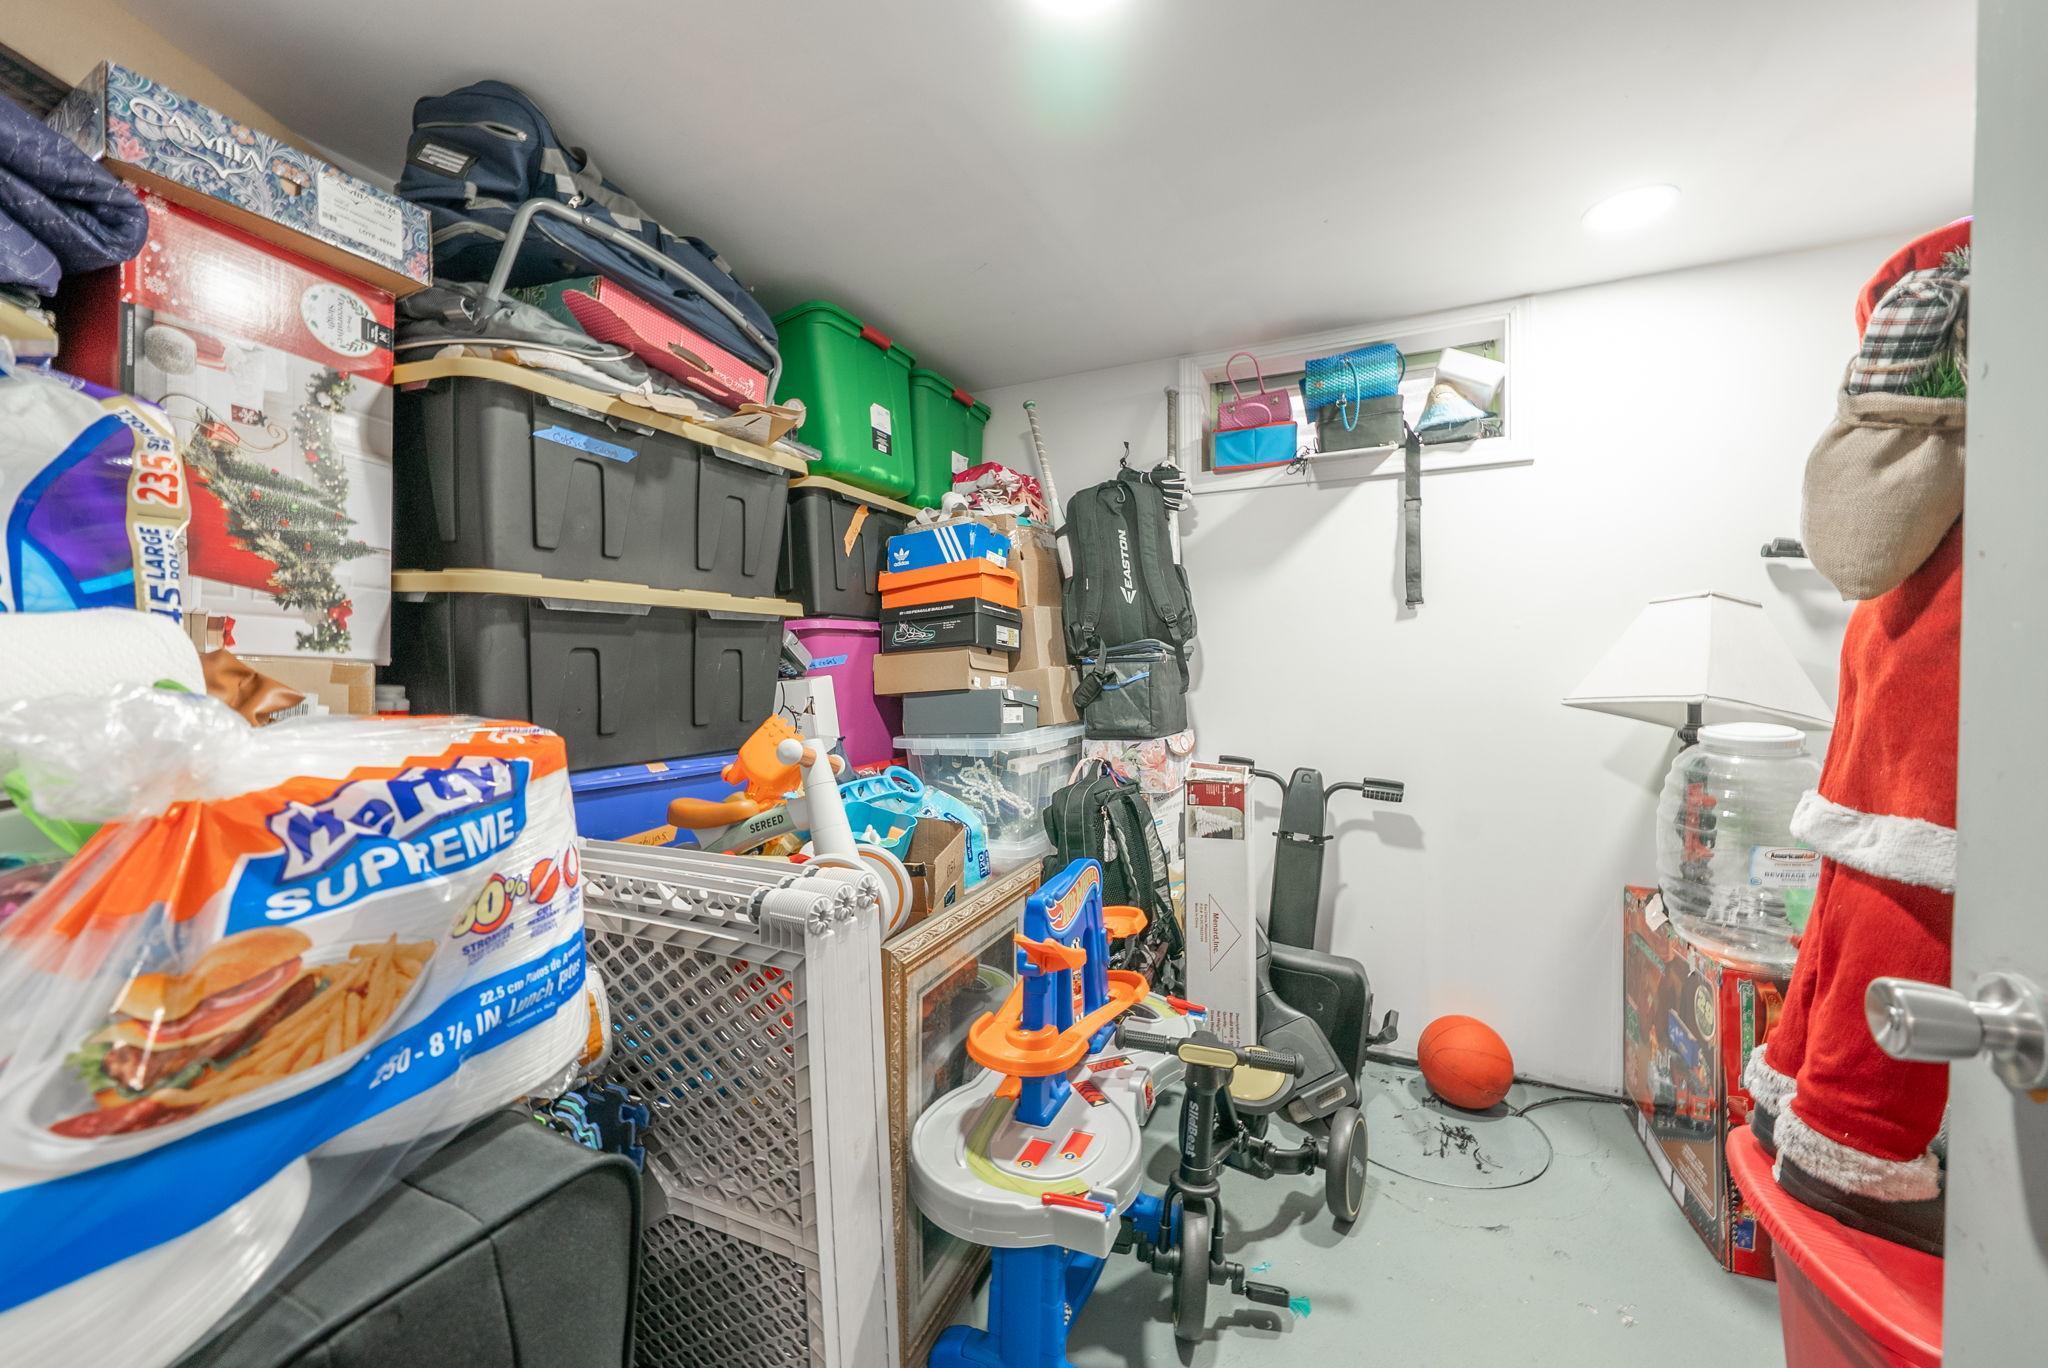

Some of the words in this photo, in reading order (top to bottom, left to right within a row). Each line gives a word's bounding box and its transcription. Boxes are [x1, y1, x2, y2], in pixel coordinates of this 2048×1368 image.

[136, 454, 178, 505] 235
[139, 526, 166, 579] LARGE
[893, 560, 910, 568] adidas
[1117, 529, 1133, 589] EASTON
[749, 814, 785, 834] SEREED
[265, 807, 516, 921] SUPREME
[480, 985, 505, 1007] 22.5
[507, 979, 525, 995] cm
[550, 957, 561, 971] de
[507, 978, 554, 1018] Lunch
[369, 1047, 412, 1090] 250
[429, 1032, 445, 1058] 8
